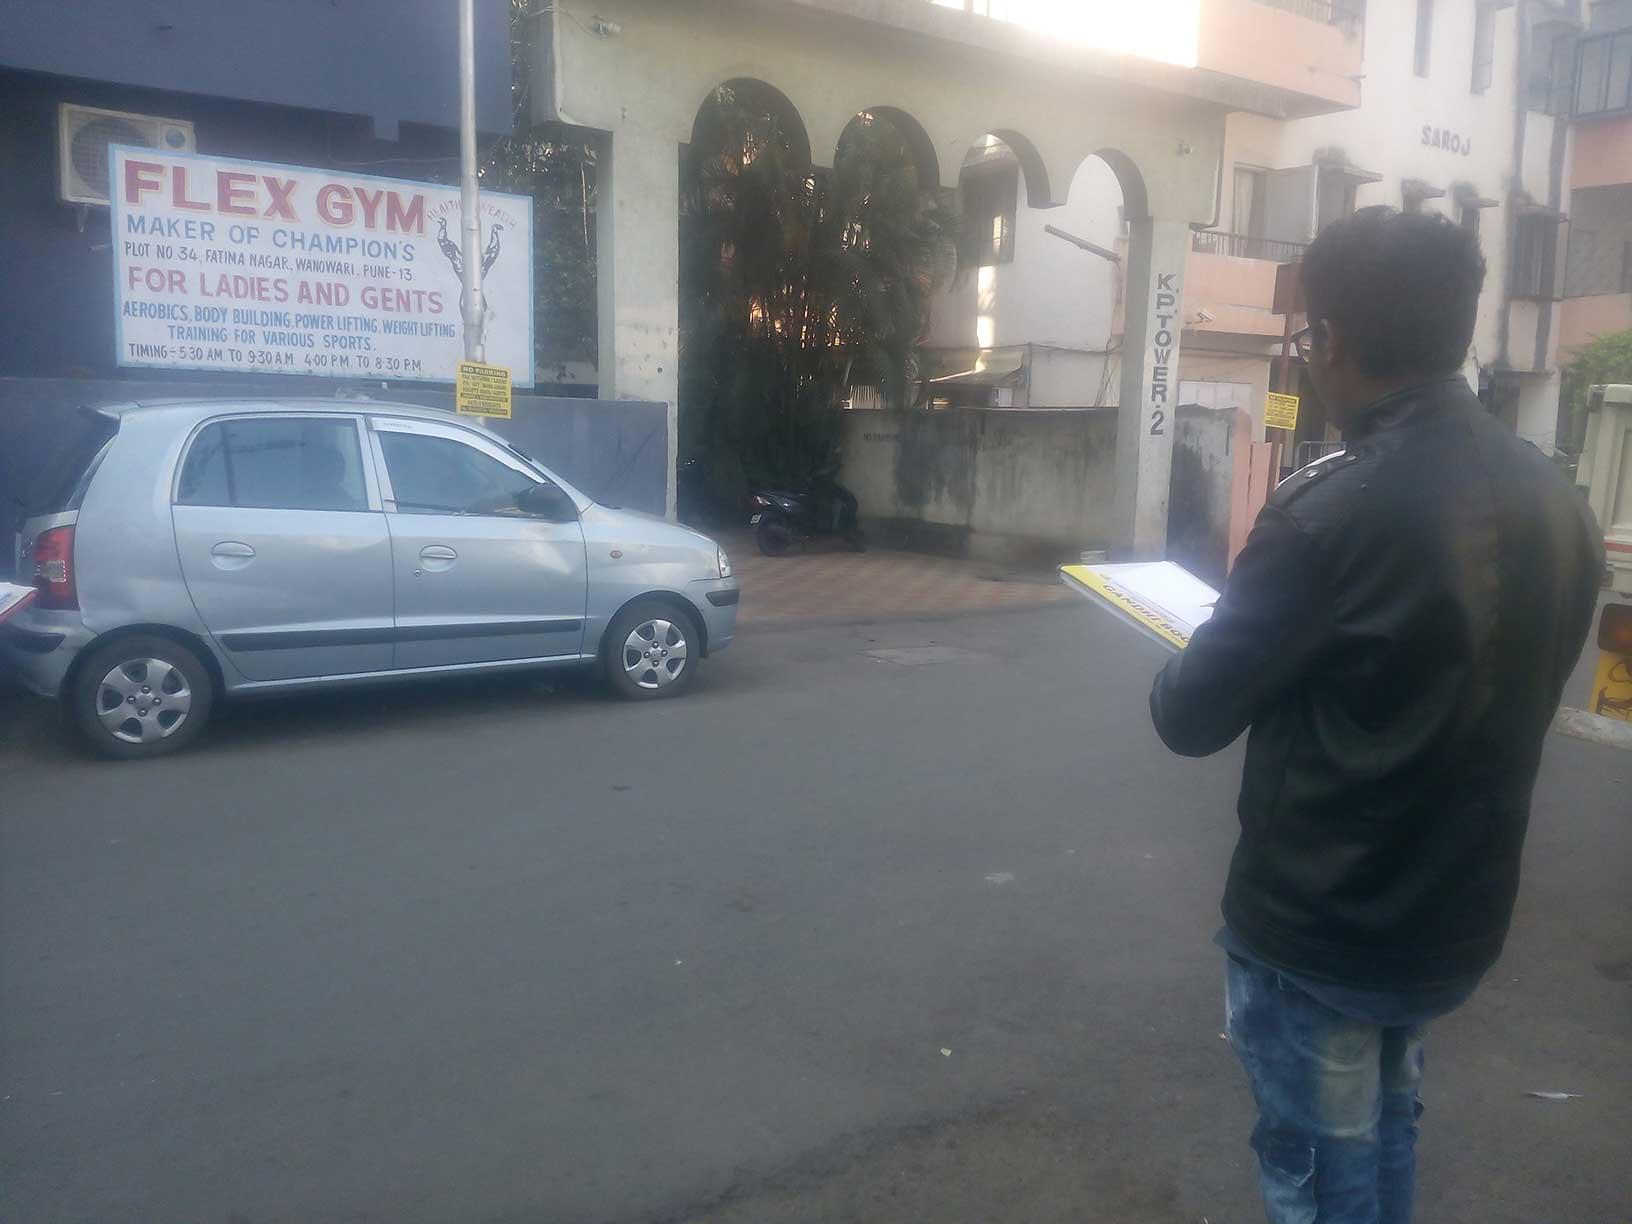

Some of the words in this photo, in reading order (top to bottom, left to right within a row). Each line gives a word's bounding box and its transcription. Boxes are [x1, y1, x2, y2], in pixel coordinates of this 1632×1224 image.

[1421, 125, 1471, 156] SAROJ
[124, 159, 298, 221] FLEX
[316, 183, 424, 234] GYM
[127, 214, 216, 241] MAKER
[229, 224, 260, 244] OF
[272, 228, 416, 262] CHAMPION'S
[124, 241, 151, 257] PLOT
[156, 244, 173, 260] NO
[205, 249, 246, 267] FATIMA
[249, 253, 293, 272] NAGAR,
[128, 265, 188, 295] FOR
[200, 272, 289, 303] LADIES
[297, 280, 350, 307] AND
[361, 286, 444, 314] GENTS
[194, 305, 228, 324] BODY
[295, 313, 334, 331] POWER
[168, 325, 228, 343] TRAINING
[234, 329, 256, 344] FOR
[262, 331, 315, 348] VARIOUS
[228, 348, 243, 362] TO
[356, 355, 370, 369] TO
